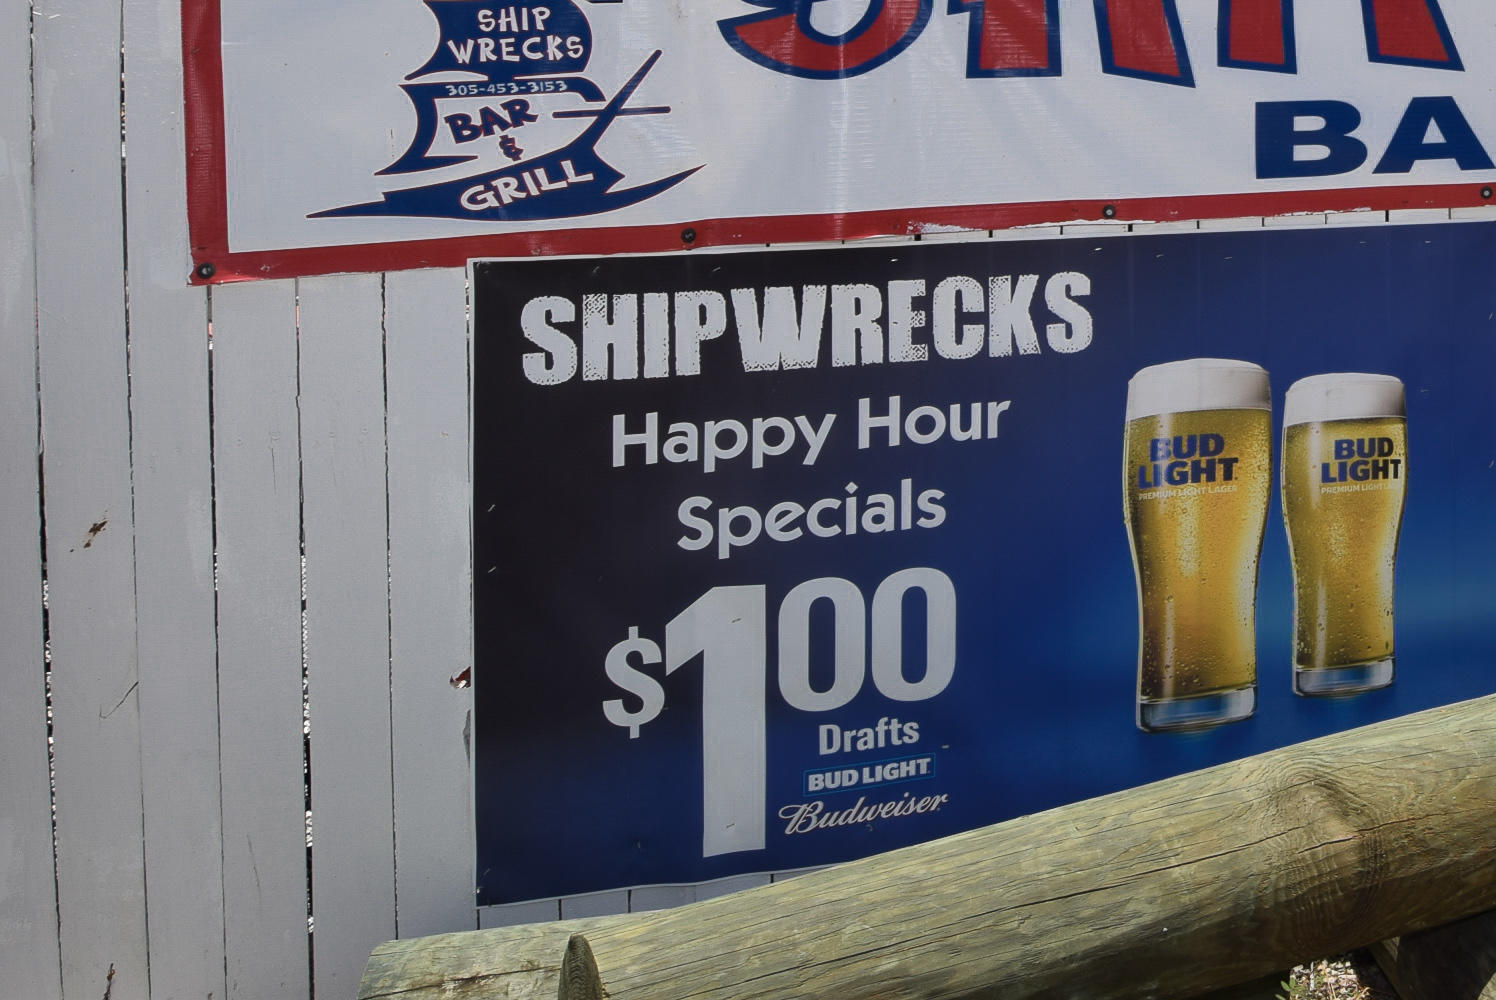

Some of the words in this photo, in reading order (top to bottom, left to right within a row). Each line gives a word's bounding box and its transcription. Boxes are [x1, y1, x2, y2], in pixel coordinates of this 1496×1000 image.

[478, 6, 551, 33] SHIP
[446, 34, 584, 64] WRECKS
[445, 80, 568, 96] 305-453-3153
[443, 98, 539, 144] BAR
[498, 134, 524, 161] &
[460, 160, 594, 211] GRILL
[520, 271, 1094, 386] SHIPWRECKS
[611, 411, 837, 474] Happy
[857, 395, 1011, 449] Hour
[1150, 433, 1225, 462] BUD
[1334, 437, 1394, 460] BUD
[1137, 457, 1239, 490] LIGHT
[1321, 459, 1402, 483] LIGHT
[1320, 485, 1360, 494] PREMIUM
[676, 478, 948, 560] Specials
[818, 717, 920, 756] Drafts
[808, 769, 859, 792] BUD
[862, 758, 932, 784] LIGHT
[778, 792, 949, 835] Budweiser
